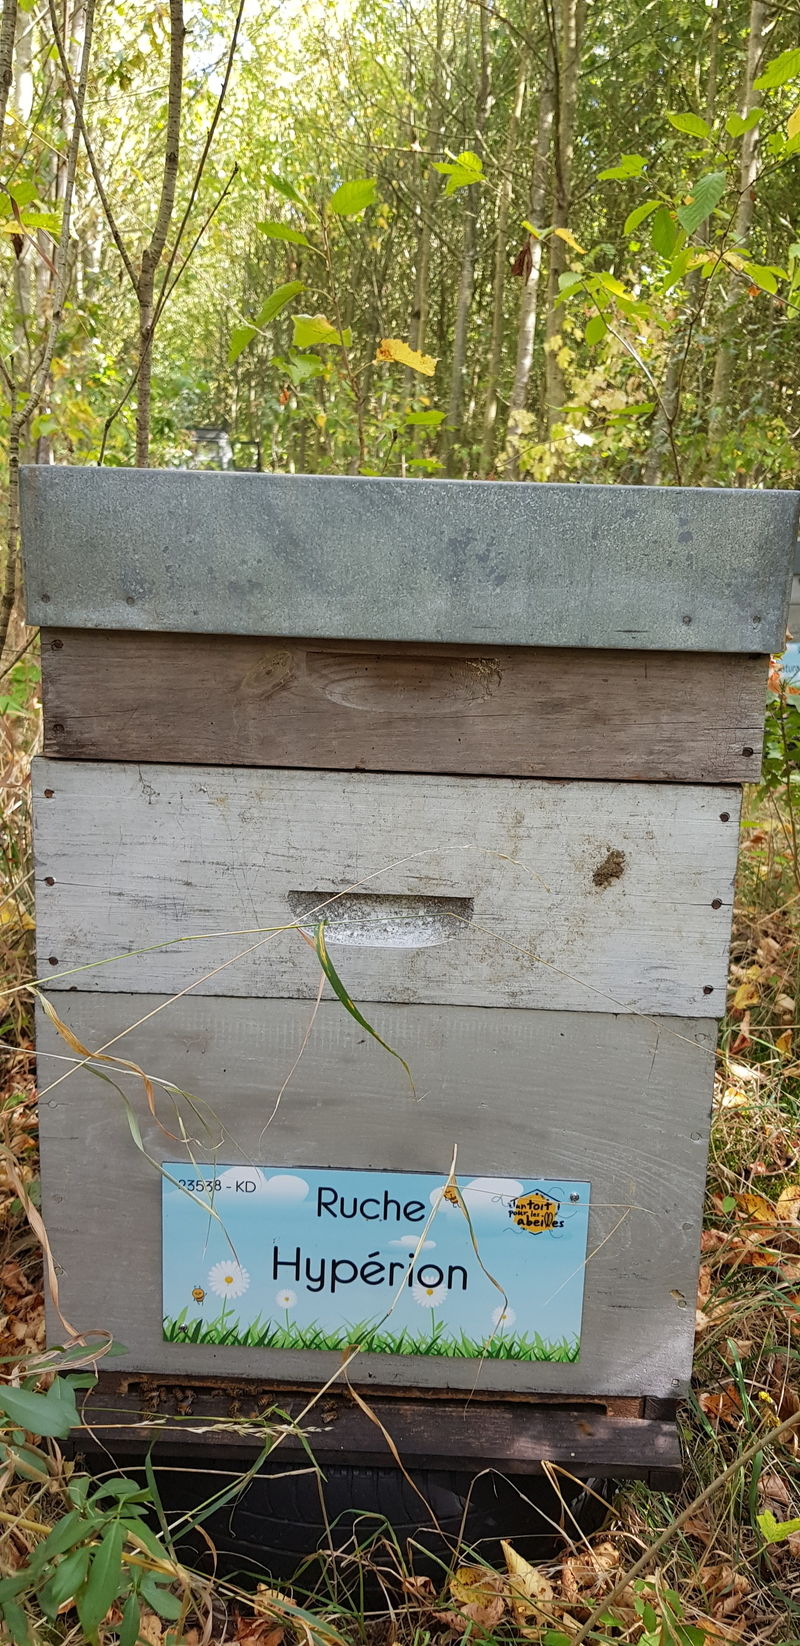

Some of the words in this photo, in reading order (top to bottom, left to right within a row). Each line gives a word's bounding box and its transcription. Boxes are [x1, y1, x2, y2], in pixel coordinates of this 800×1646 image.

[235, 1180, 256, 1193] KD
[317, 1187, 425, 1221] Ruche
[527, 1199, 552, 1211] toit
[517, 1212, 565, 1228] abeilles
[272, 1245, 468, 1293] Hypérion
